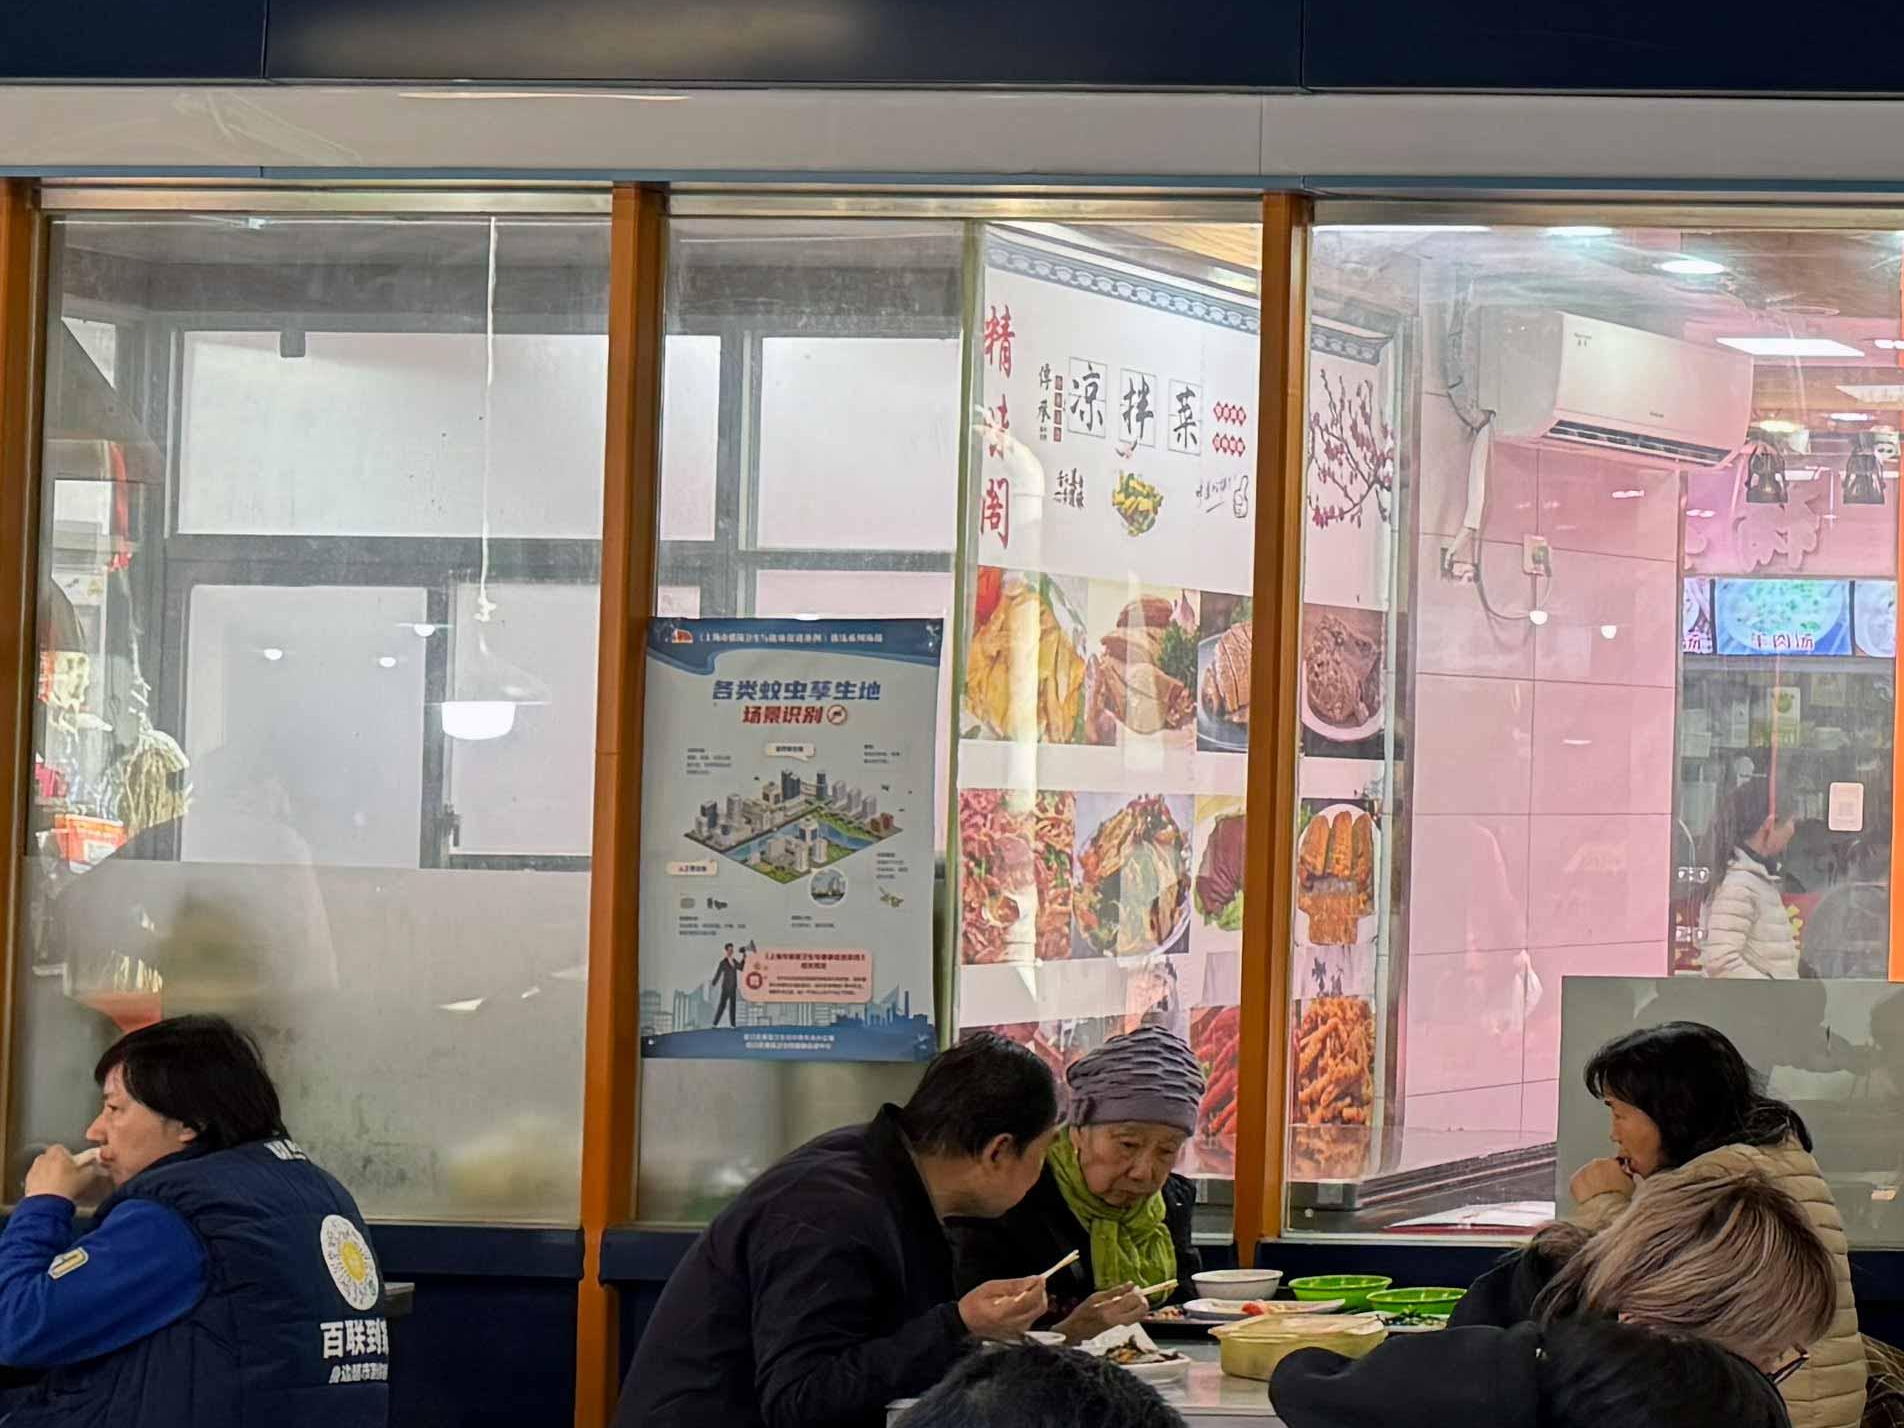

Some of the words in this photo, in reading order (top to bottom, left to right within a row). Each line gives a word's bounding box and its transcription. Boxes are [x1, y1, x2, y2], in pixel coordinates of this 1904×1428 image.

[1068, 363, 1199, 450] 凉拌菜
[742, 704, 824, 725] 场景识别
